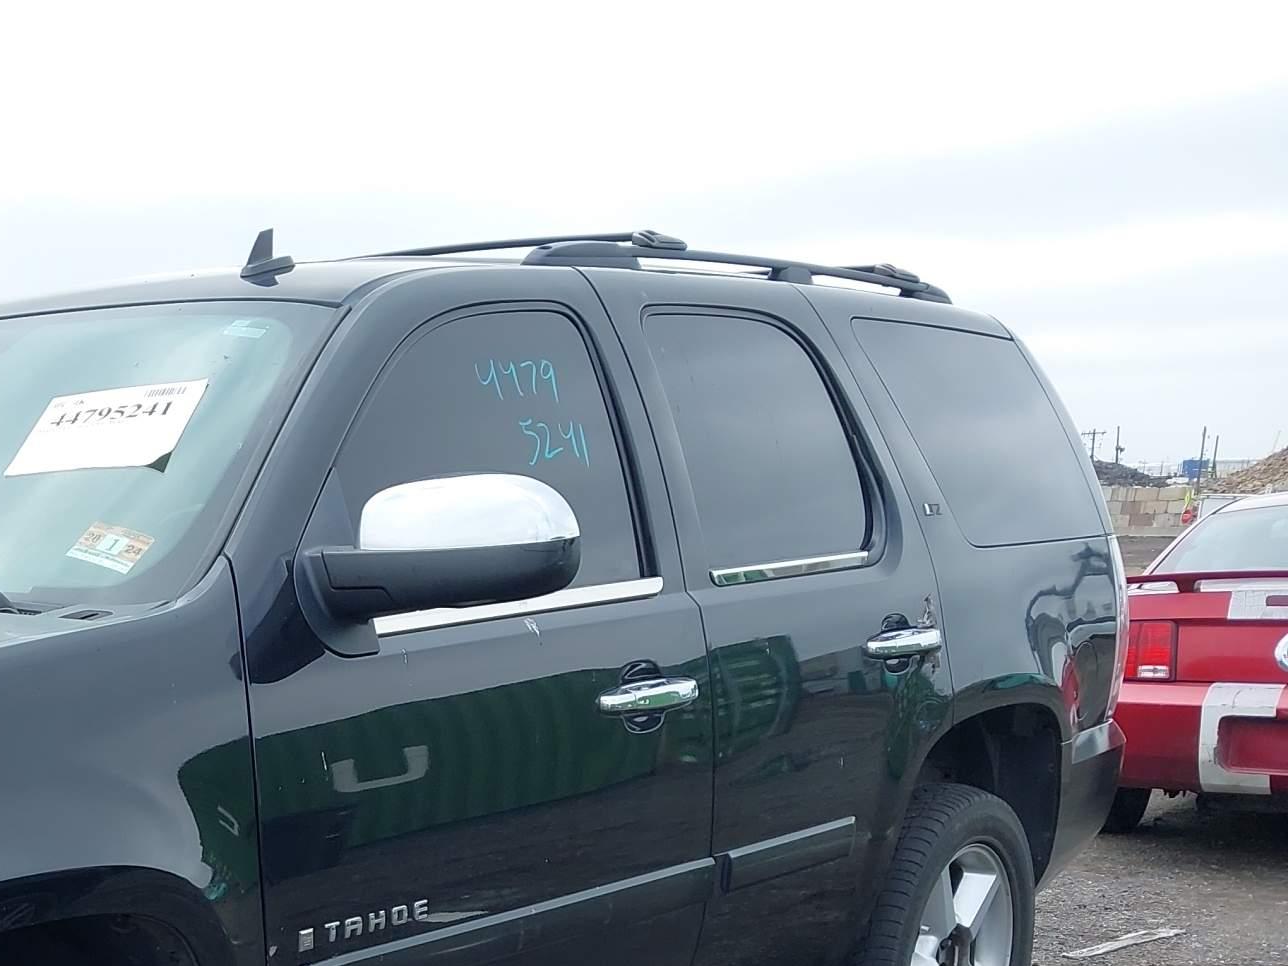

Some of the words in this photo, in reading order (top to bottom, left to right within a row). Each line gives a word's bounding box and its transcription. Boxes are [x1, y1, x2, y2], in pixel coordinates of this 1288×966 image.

[474, 359, 559, 403] 4479
[50, 402, 173, 426] 44795241
[518, 418, 590, 468] 5241
[105, 538, 121, 552] 1
[324, 899, 429, 943] TAHOE
